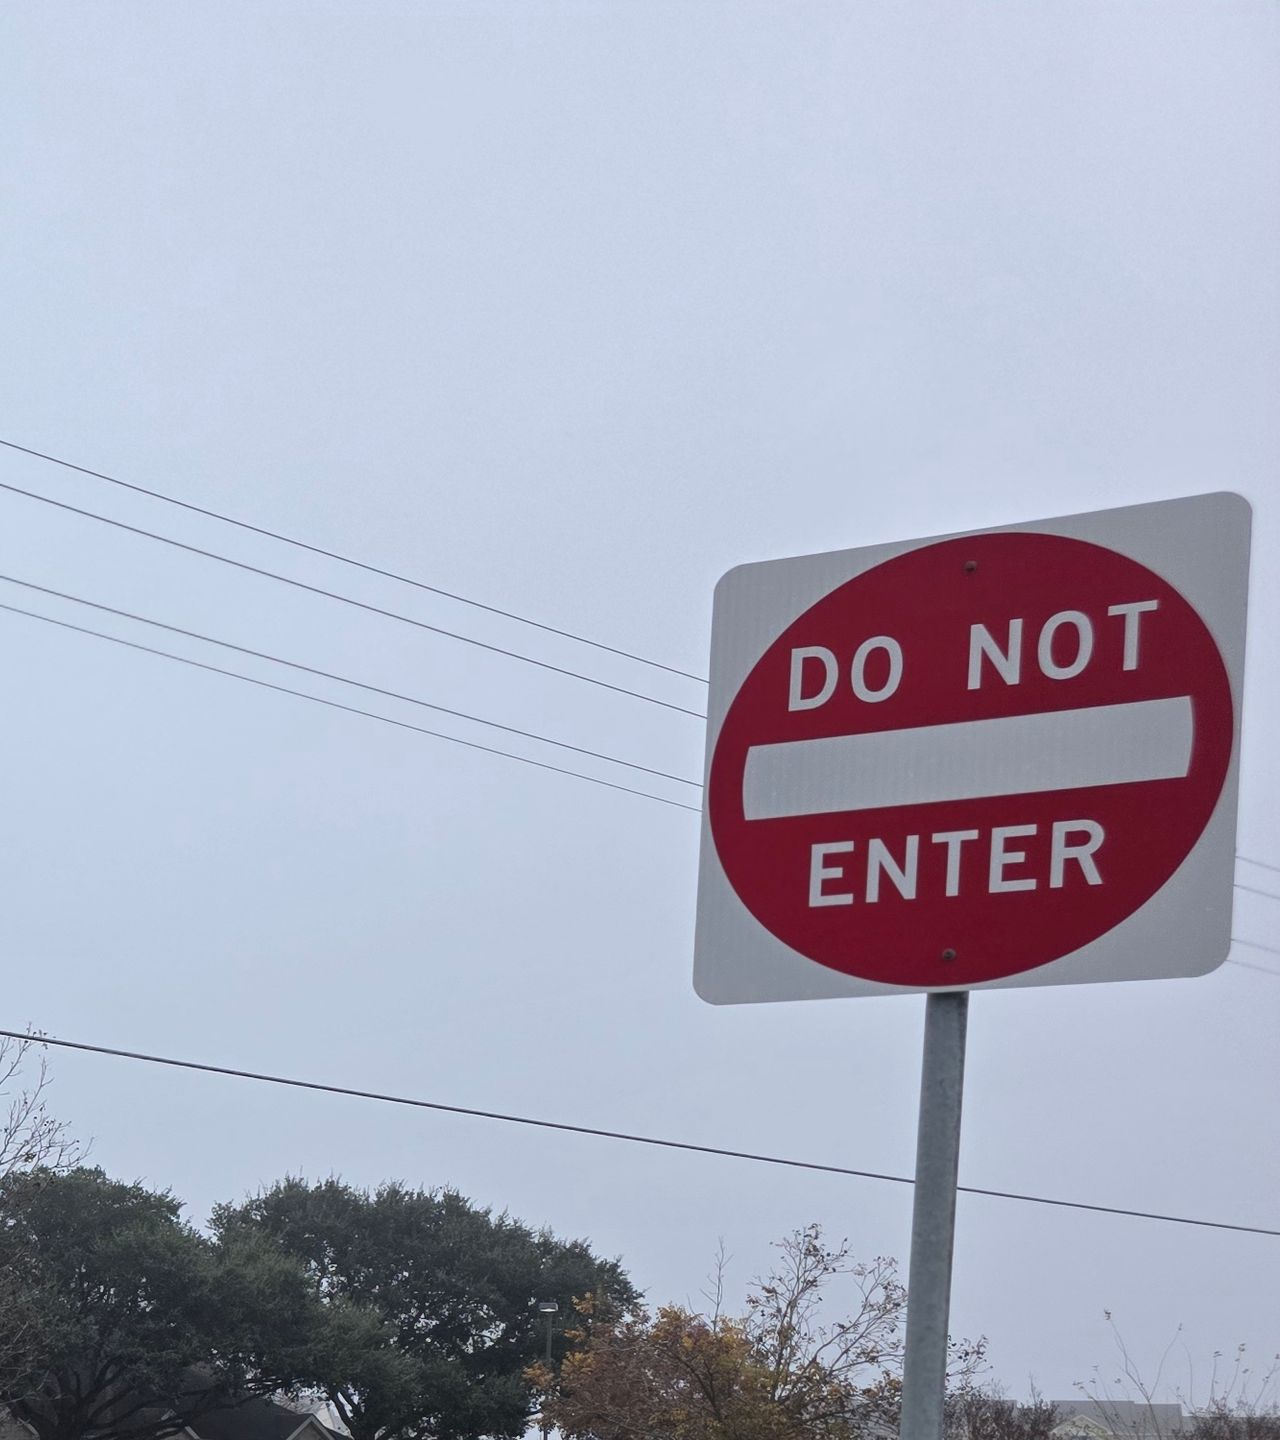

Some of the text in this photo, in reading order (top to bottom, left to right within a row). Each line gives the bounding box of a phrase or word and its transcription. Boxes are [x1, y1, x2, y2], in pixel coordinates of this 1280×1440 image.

[787, 599, 1159, 712] DO NOT
[808, 819, 1105, 908] ENTER
